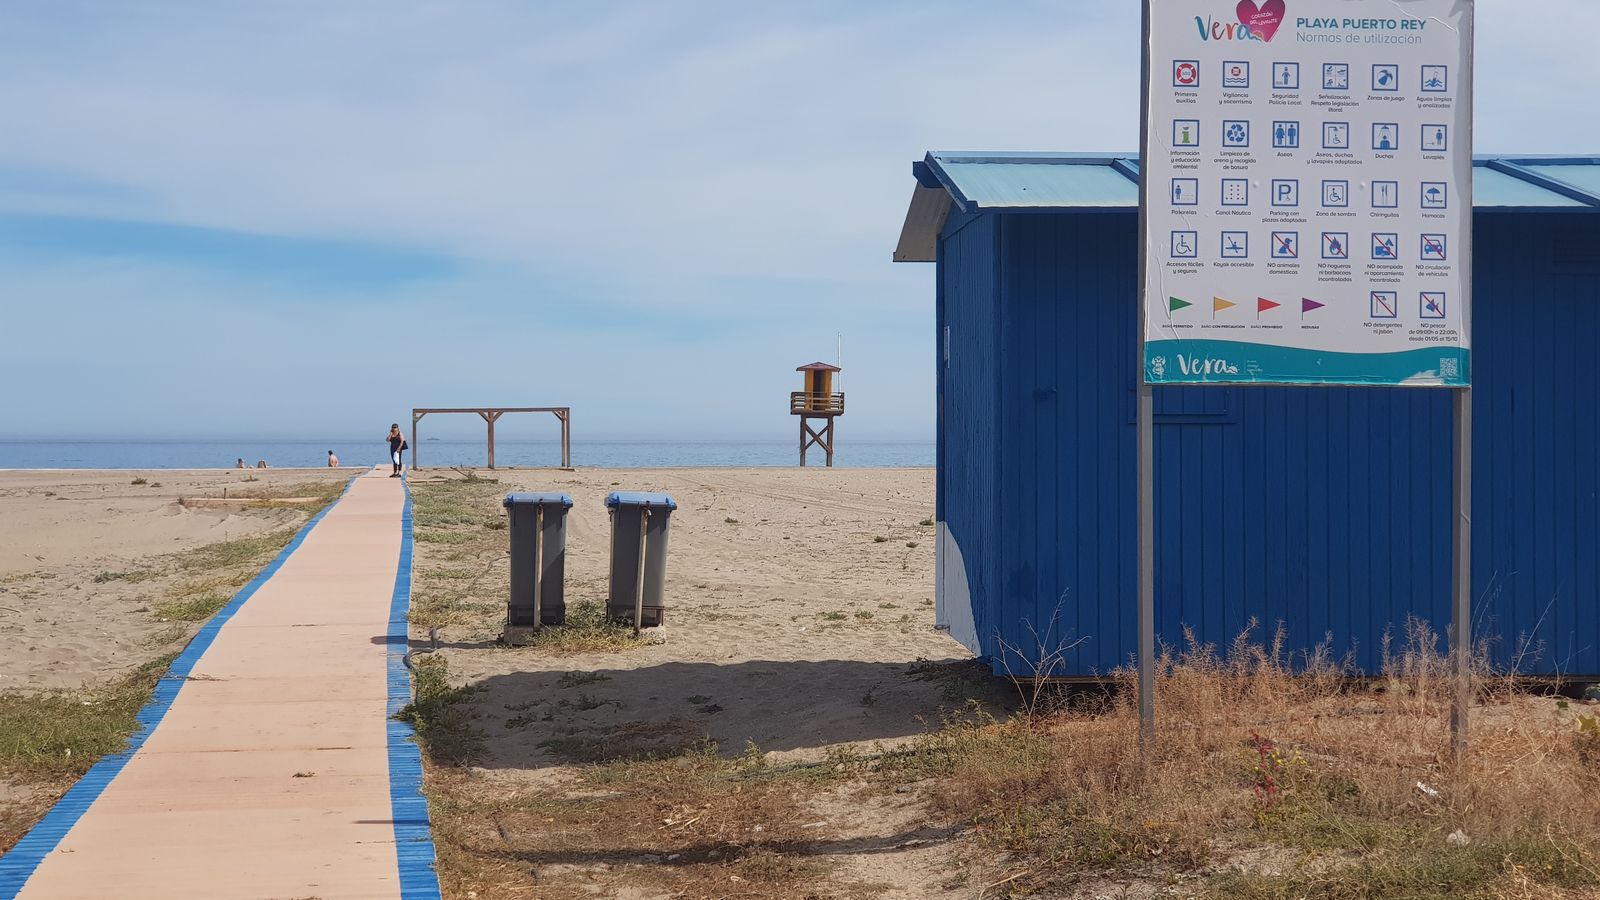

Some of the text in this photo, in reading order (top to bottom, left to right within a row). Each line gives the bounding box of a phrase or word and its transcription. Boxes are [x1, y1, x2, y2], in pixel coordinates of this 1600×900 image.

[1195, 14, 1258, 41] Vera
[1296, 18, 1426, 30] PLAYA PUERTO REY
[1296, 32, 1422, 44] Normas de utilización
[1177, 352, 1229, 375] Vera
